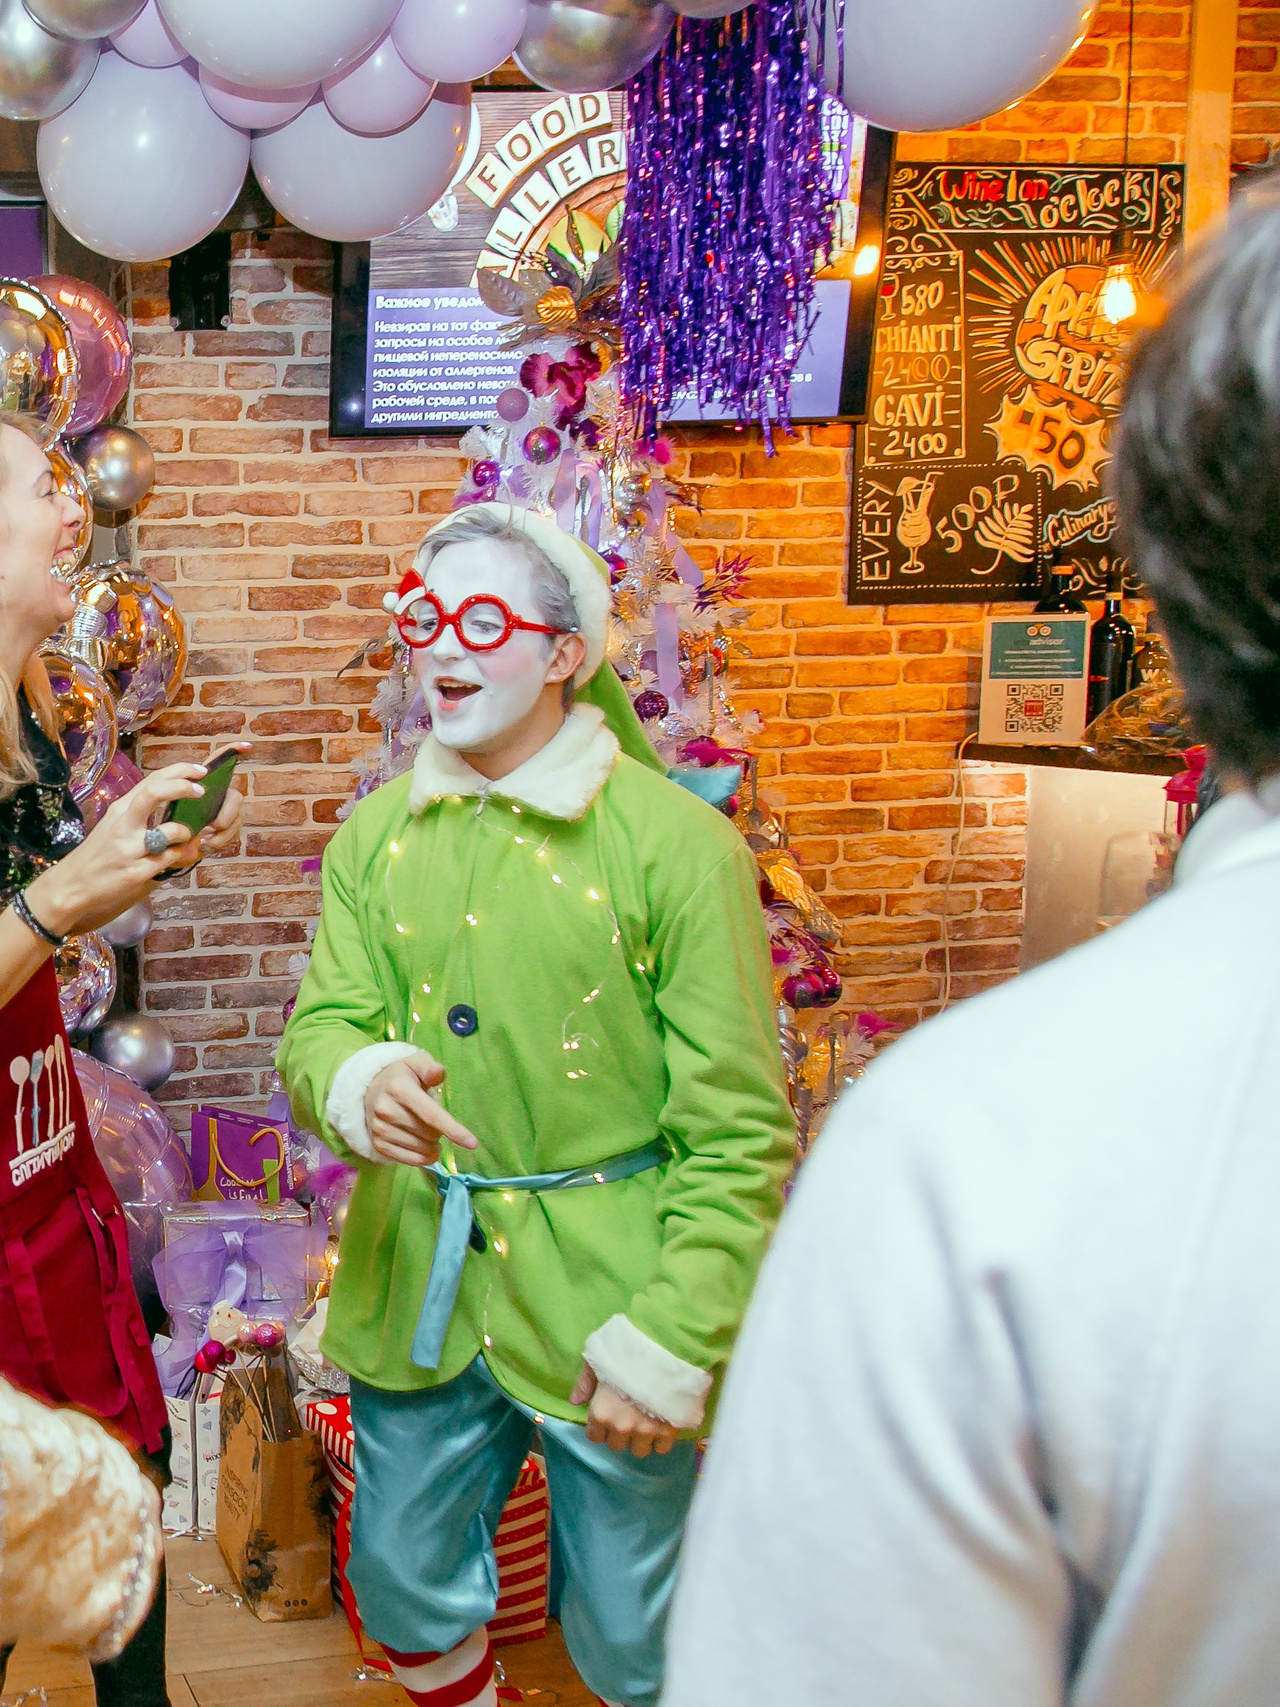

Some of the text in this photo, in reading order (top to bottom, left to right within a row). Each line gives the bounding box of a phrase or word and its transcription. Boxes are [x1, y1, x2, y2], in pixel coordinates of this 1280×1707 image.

[477, 94, 601, 192] FOOD
[936, 170, 1004, 202] Wine
[482, 139, 620, 276] LLER
[375, 295, 431, 309] Важное
[901, 280, 944, 316] 580
[374, 320, 431, 334] Невзирая
[432, 322, 450, 333] на
[450, 321, 469, 332] тот
[876, 316, 962, 353] CHIANTI
[374, 337, 427, 350] запросы
[428, 336, 445, 347] на
[446, 333, 494, 347] особое
[373, 350, 525, 363] пищевой непереносимо
[373, 365, 517, 378] изоляции от аллергенов.
[882, 354, 951, 387] 2400
[372, 380, 396, 392] Это
[396, 379, 476, 393] обусловлено
[372, 394, 425, 409] рабочей
[426, 395, 468, 408] среде,
[469, 395, 478, 405] в
[371, 411, 422, 424] другими
[882, 430, 948, 459] 2400
[862, 480, 894, 581] EVERY
